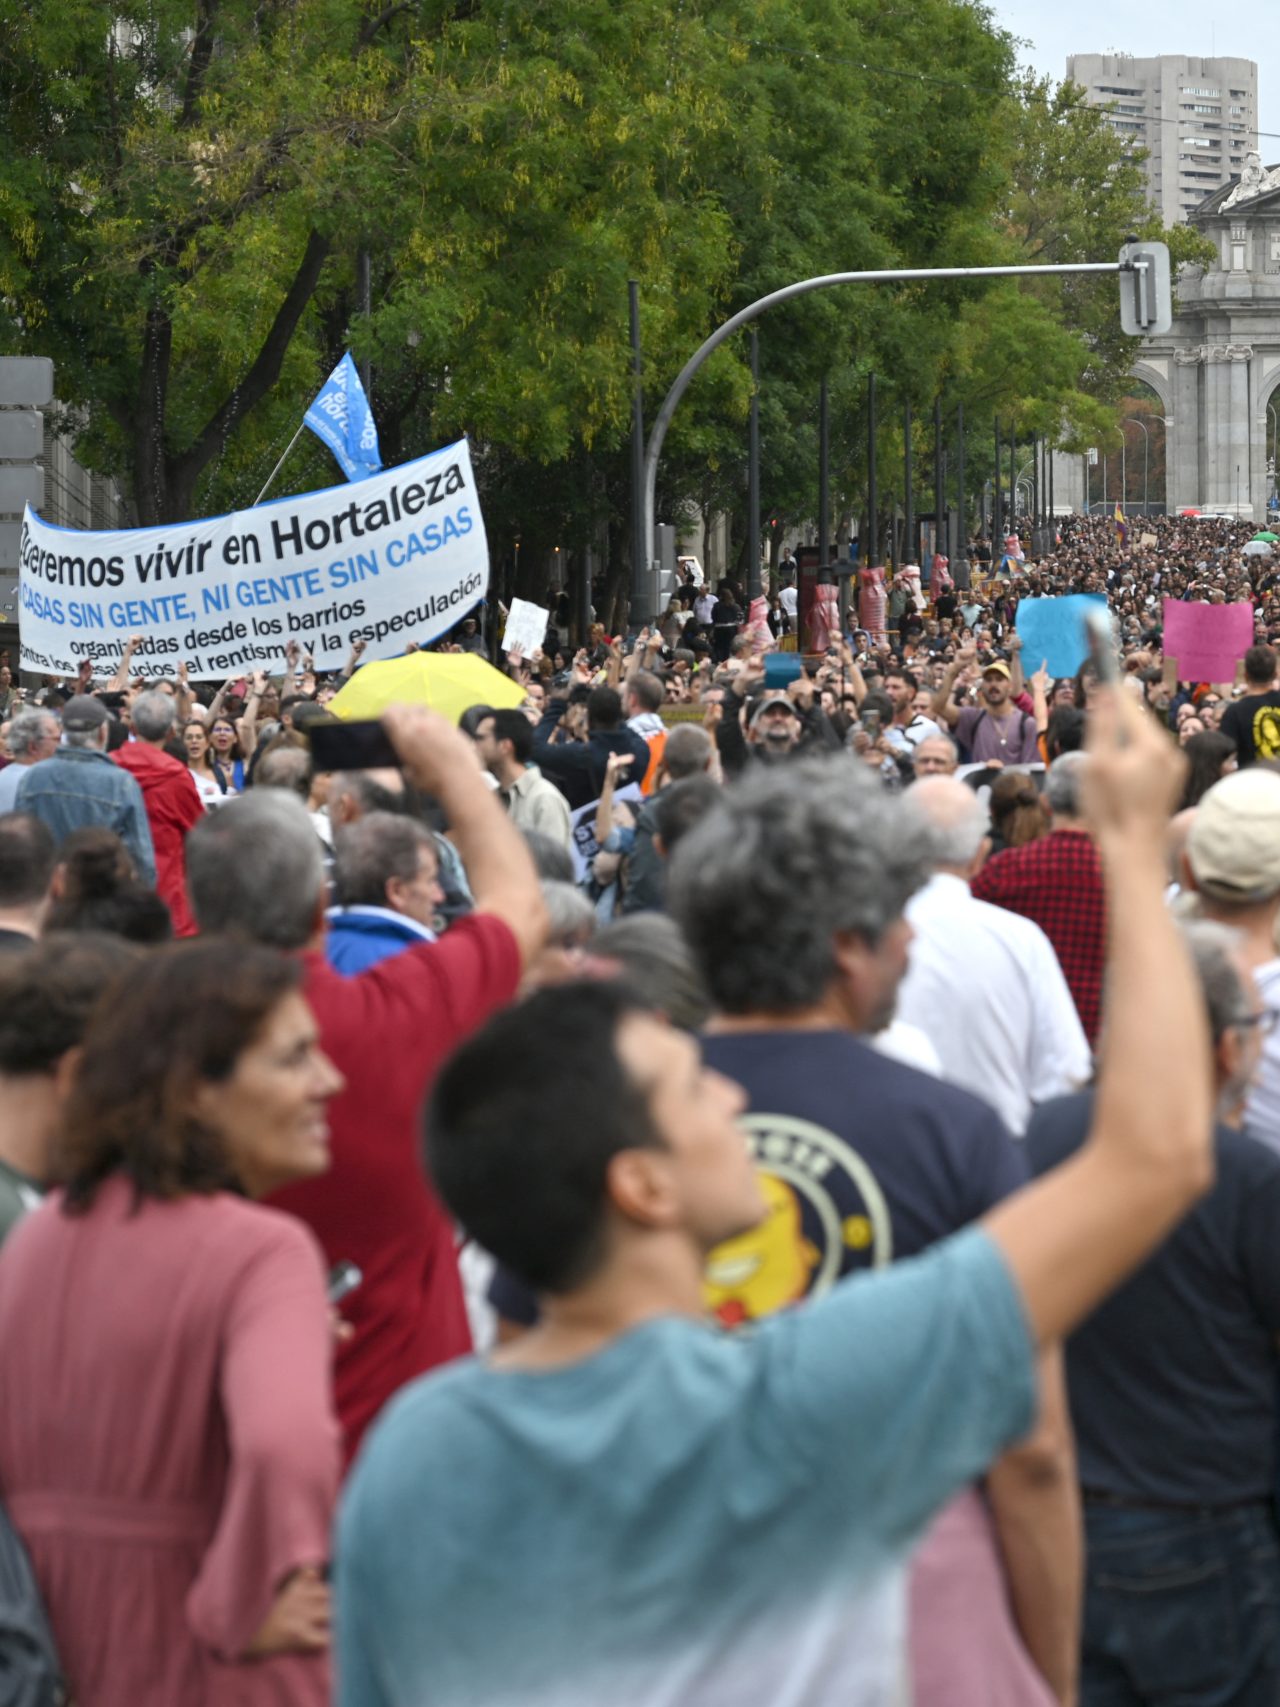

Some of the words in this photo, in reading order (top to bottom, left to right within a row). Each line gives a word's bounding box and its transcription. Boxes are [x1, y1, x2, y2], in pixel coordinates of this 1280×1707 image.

[22, 582, 65, 625] CASAS
[68, 601, 104, 628] SIN
[108, 592, 197, 628] GENTE,
[201, 583, 230, 615] NI
[235, 568, 325, 608] GENTE
[327, 549, 380, 589] SIN
[385, 506, 474, 569] CASAS
[134, 537, 212, 584] vivir
[222, 533, 262, 566] en
[270, 463, 466, 560] Hortaleza
[20, 642, 50, 668] ontra
[49, 654, 75, 672] los
[186, 655, 204, 674] el
[206, 643, 289, 672] rentism
[303, 640, 316, 656] y
[321, 633, 343, 651] la
[348, 572, 482, 643] especulación
[69, 635, 180, 661] organiadas
[183, 620, 248, 650] desde
[251, 616, 283, 637] los
[287, 599, 366, 633] barrios
